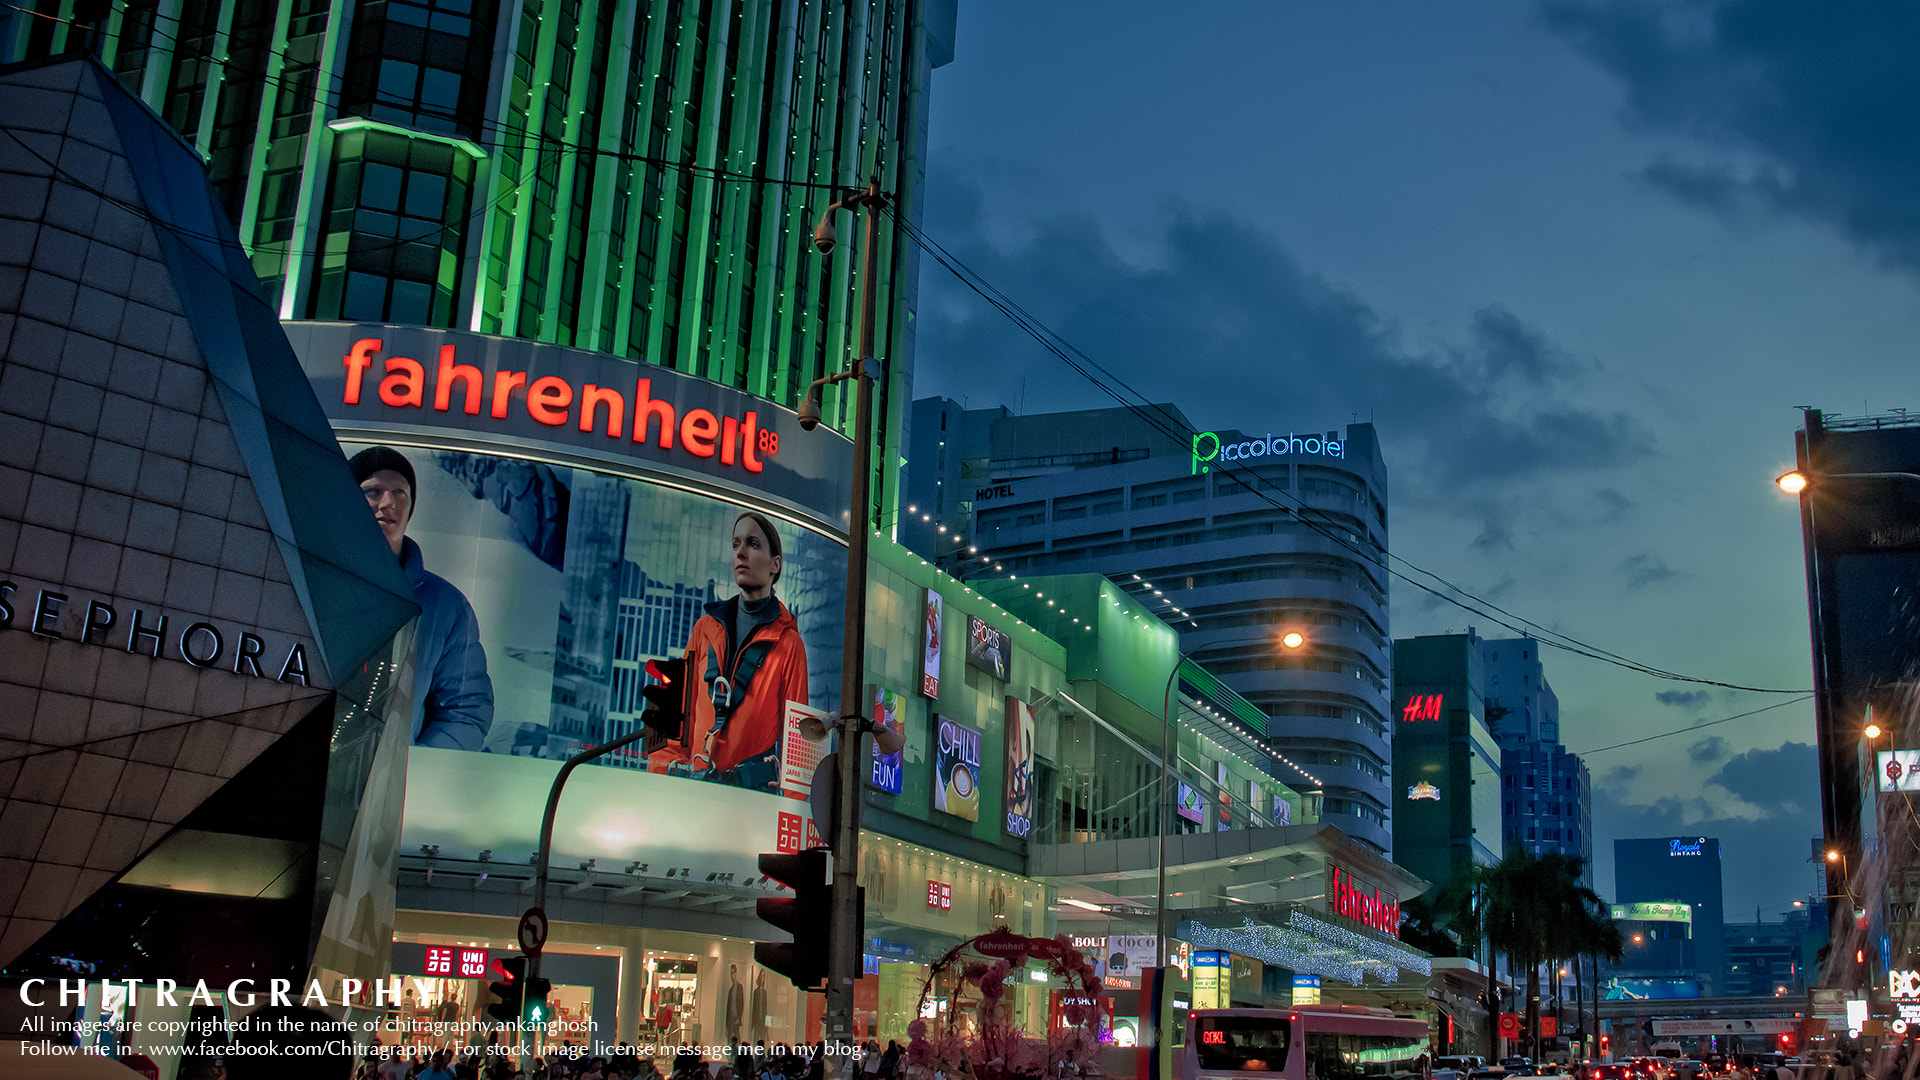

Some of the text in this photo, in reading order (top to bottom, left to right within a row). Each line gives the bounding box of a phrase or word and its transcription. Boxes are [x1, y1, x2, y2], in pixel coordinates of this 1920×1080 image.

[343, 339, 764, 473] fahrenheit
[976, 485, 1015, 501] HOTEL
[0, 579, 313, 688] SEPHORA
[971, 620, 1000, 650] SPORTS
[924, 672, 939, 698] EAT
[1403, 694, 1443, 723] H&M
[938, 720, 980, 768] CHILL
[786, 768, 801, 778] JAPAN
[872, 760, 896, 790] FUN
[1007, 811, 1031, 838] SHOP
[1333, 867, 1400, 938] fahrenheit
[979, 941, 1024, 951] fahrenheit
[1072, 937, 1107, 948] BOUT
[1117, 938, 1156, 949] COCO
[461, 962, 485, 976] QLO
[462, 951, 484, 963] UNI
[1203, 1031, 1227, 1045] GOKL
